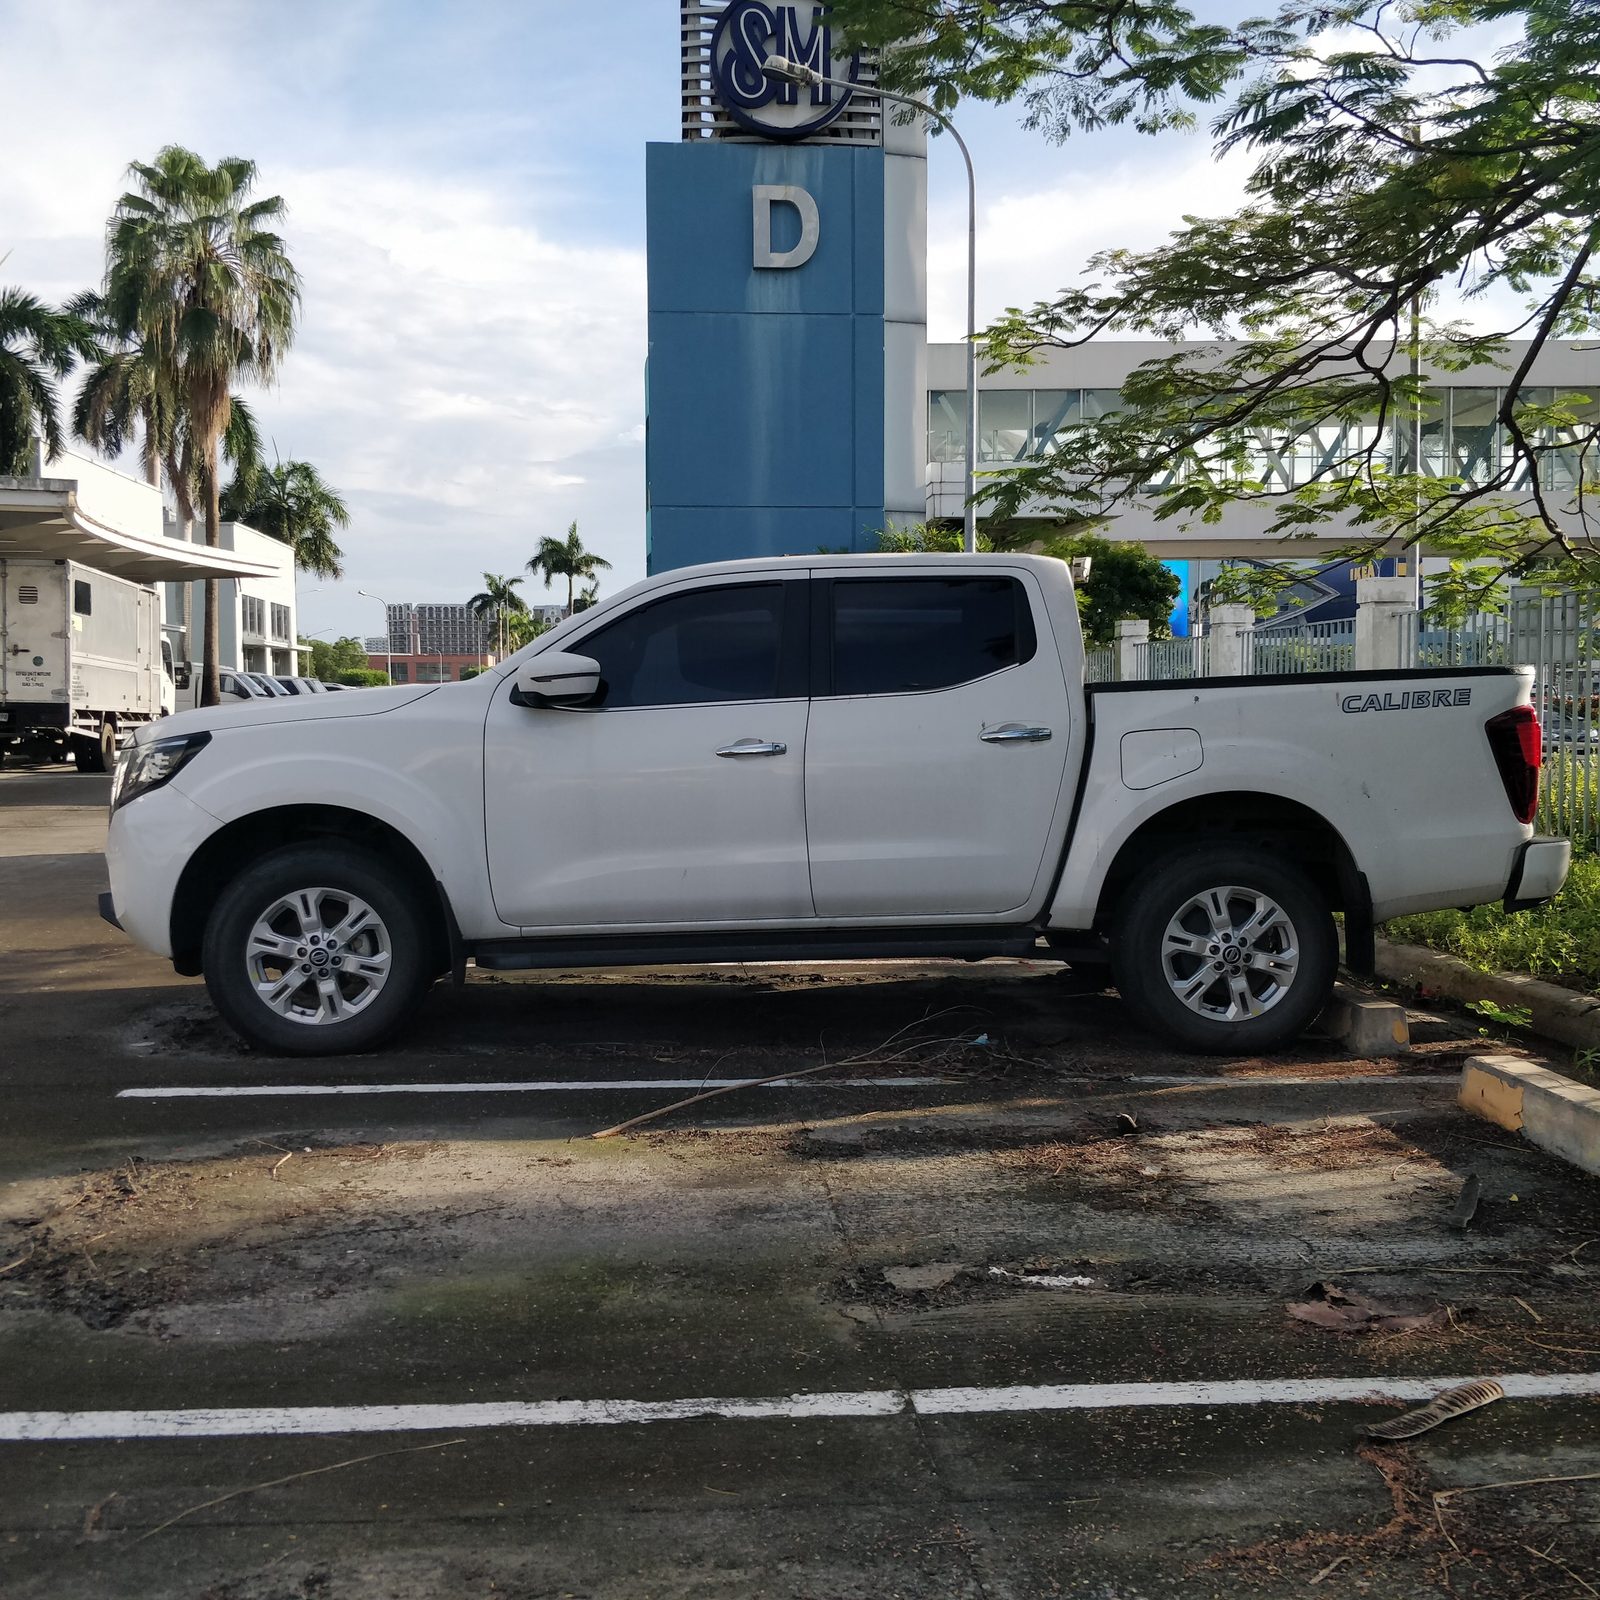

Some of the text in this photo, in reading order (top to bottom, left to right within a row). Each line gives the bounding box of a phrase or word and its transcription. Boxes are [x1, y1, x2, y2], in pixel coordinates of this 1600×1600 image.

[722, 1, 832, 108] SM
[752, 184, 820, 270] D
[1342, 688, 1471, 713] CALIBRE
